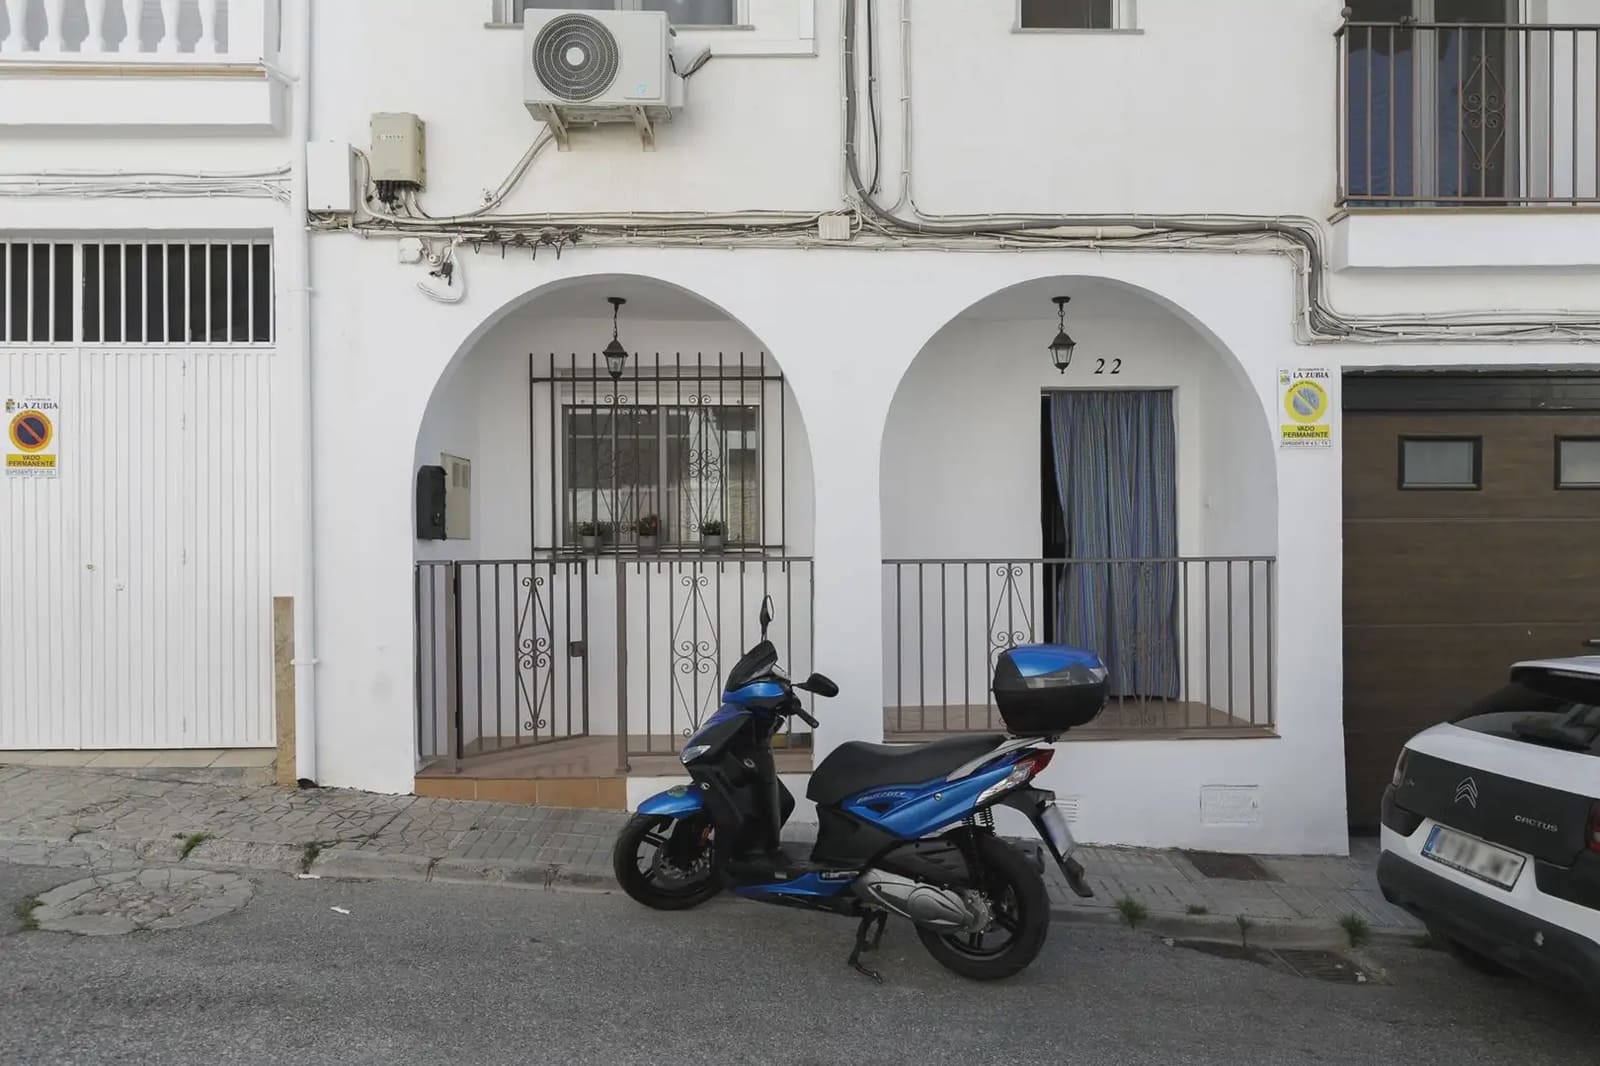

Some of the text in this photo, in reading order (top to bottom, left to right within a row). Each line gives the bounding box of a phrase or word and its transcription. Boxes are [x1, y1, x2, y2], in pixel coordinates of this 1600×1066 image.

[1094, 358, 1122, 375] 22
[31, 402, 58, 410] ZUBIA
[1514, 814, 1559, 833] CACTUS
